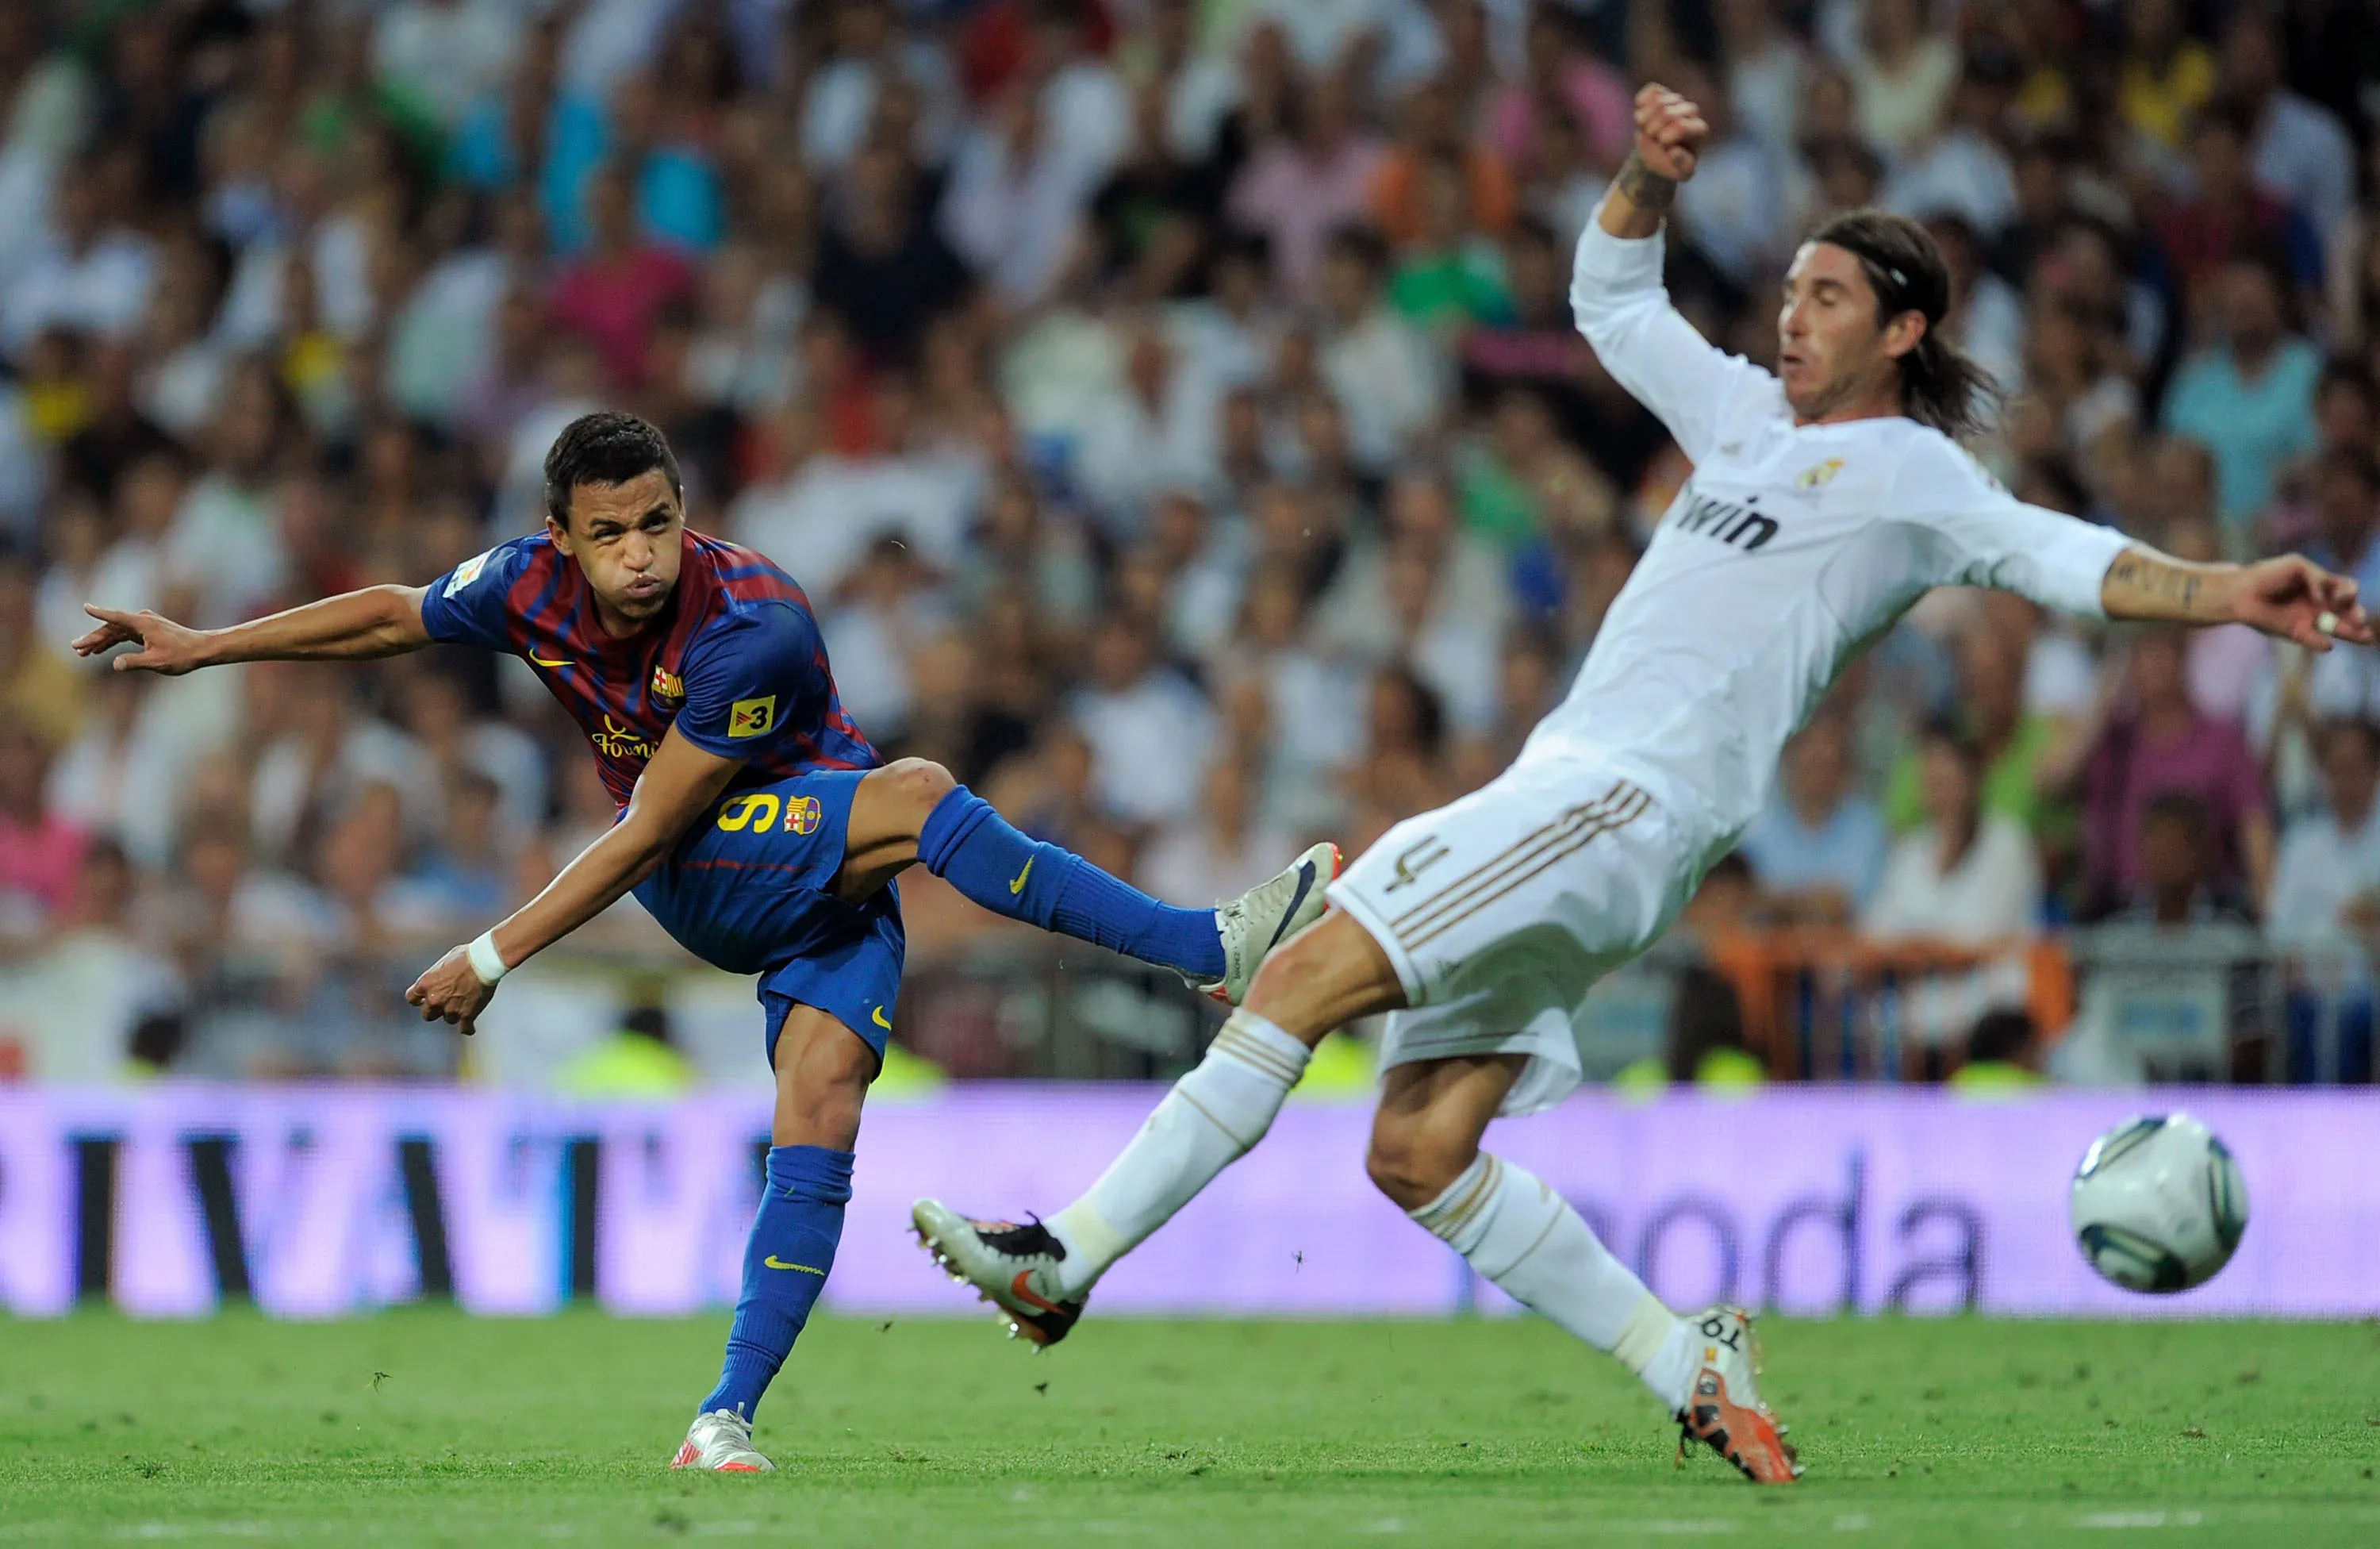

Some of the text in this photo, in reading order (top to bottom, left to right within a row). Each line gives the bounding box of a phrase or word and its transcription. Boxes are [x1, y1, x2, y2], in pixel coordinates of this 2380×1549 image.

[1676, 494, 1779, 549] win
[750, 705, 768, 729] 3
[717, 794, 780, 833] 9
[1384, 835, 1451, 894] 4
[0, 1133, 774, 1317] IVAT
